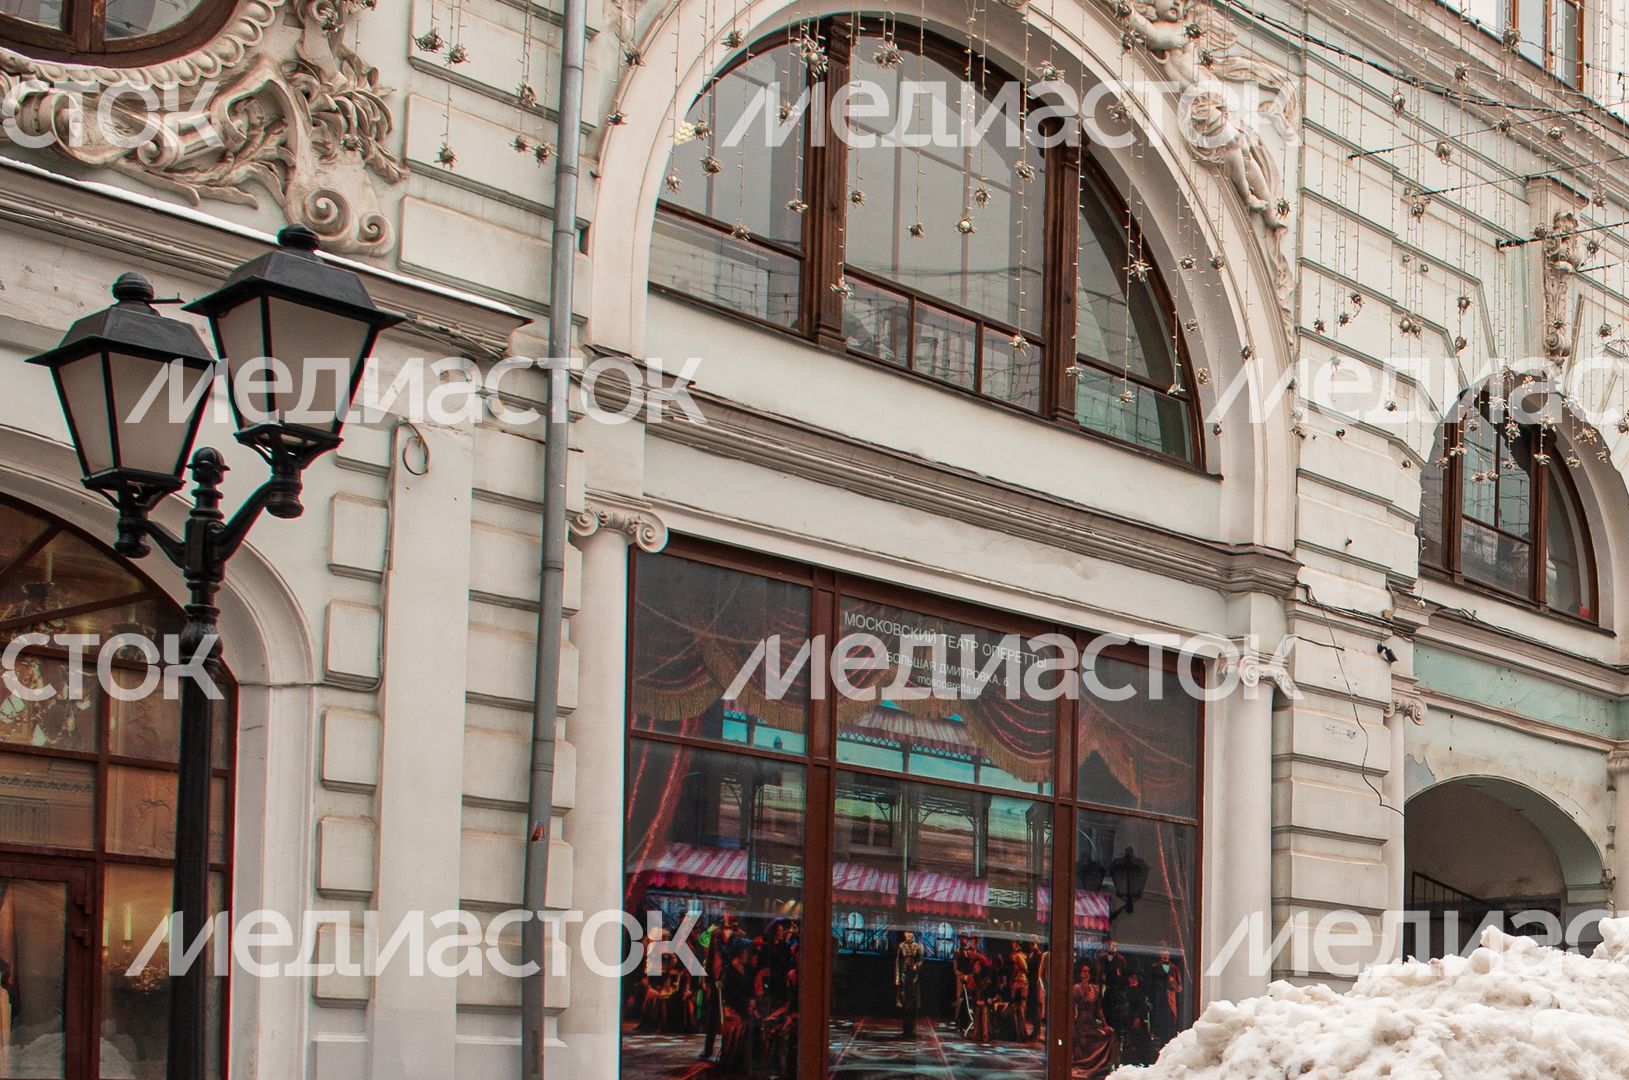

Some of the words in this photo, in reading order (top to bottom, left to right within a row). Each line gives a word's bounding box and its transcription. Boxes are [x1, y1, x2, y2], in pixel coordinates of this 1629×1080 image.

[844, 611, 937, 645] МОСКОВСКИЙ
[941, 633, 979, 653] ТЕАТР
[982, 643, 1047, 669] ОПЕРЕТТЫ
[886, 651, 937, 671] БОЛЬШАЯ
[917, 674, 983, 697] mosoperetta.ru
